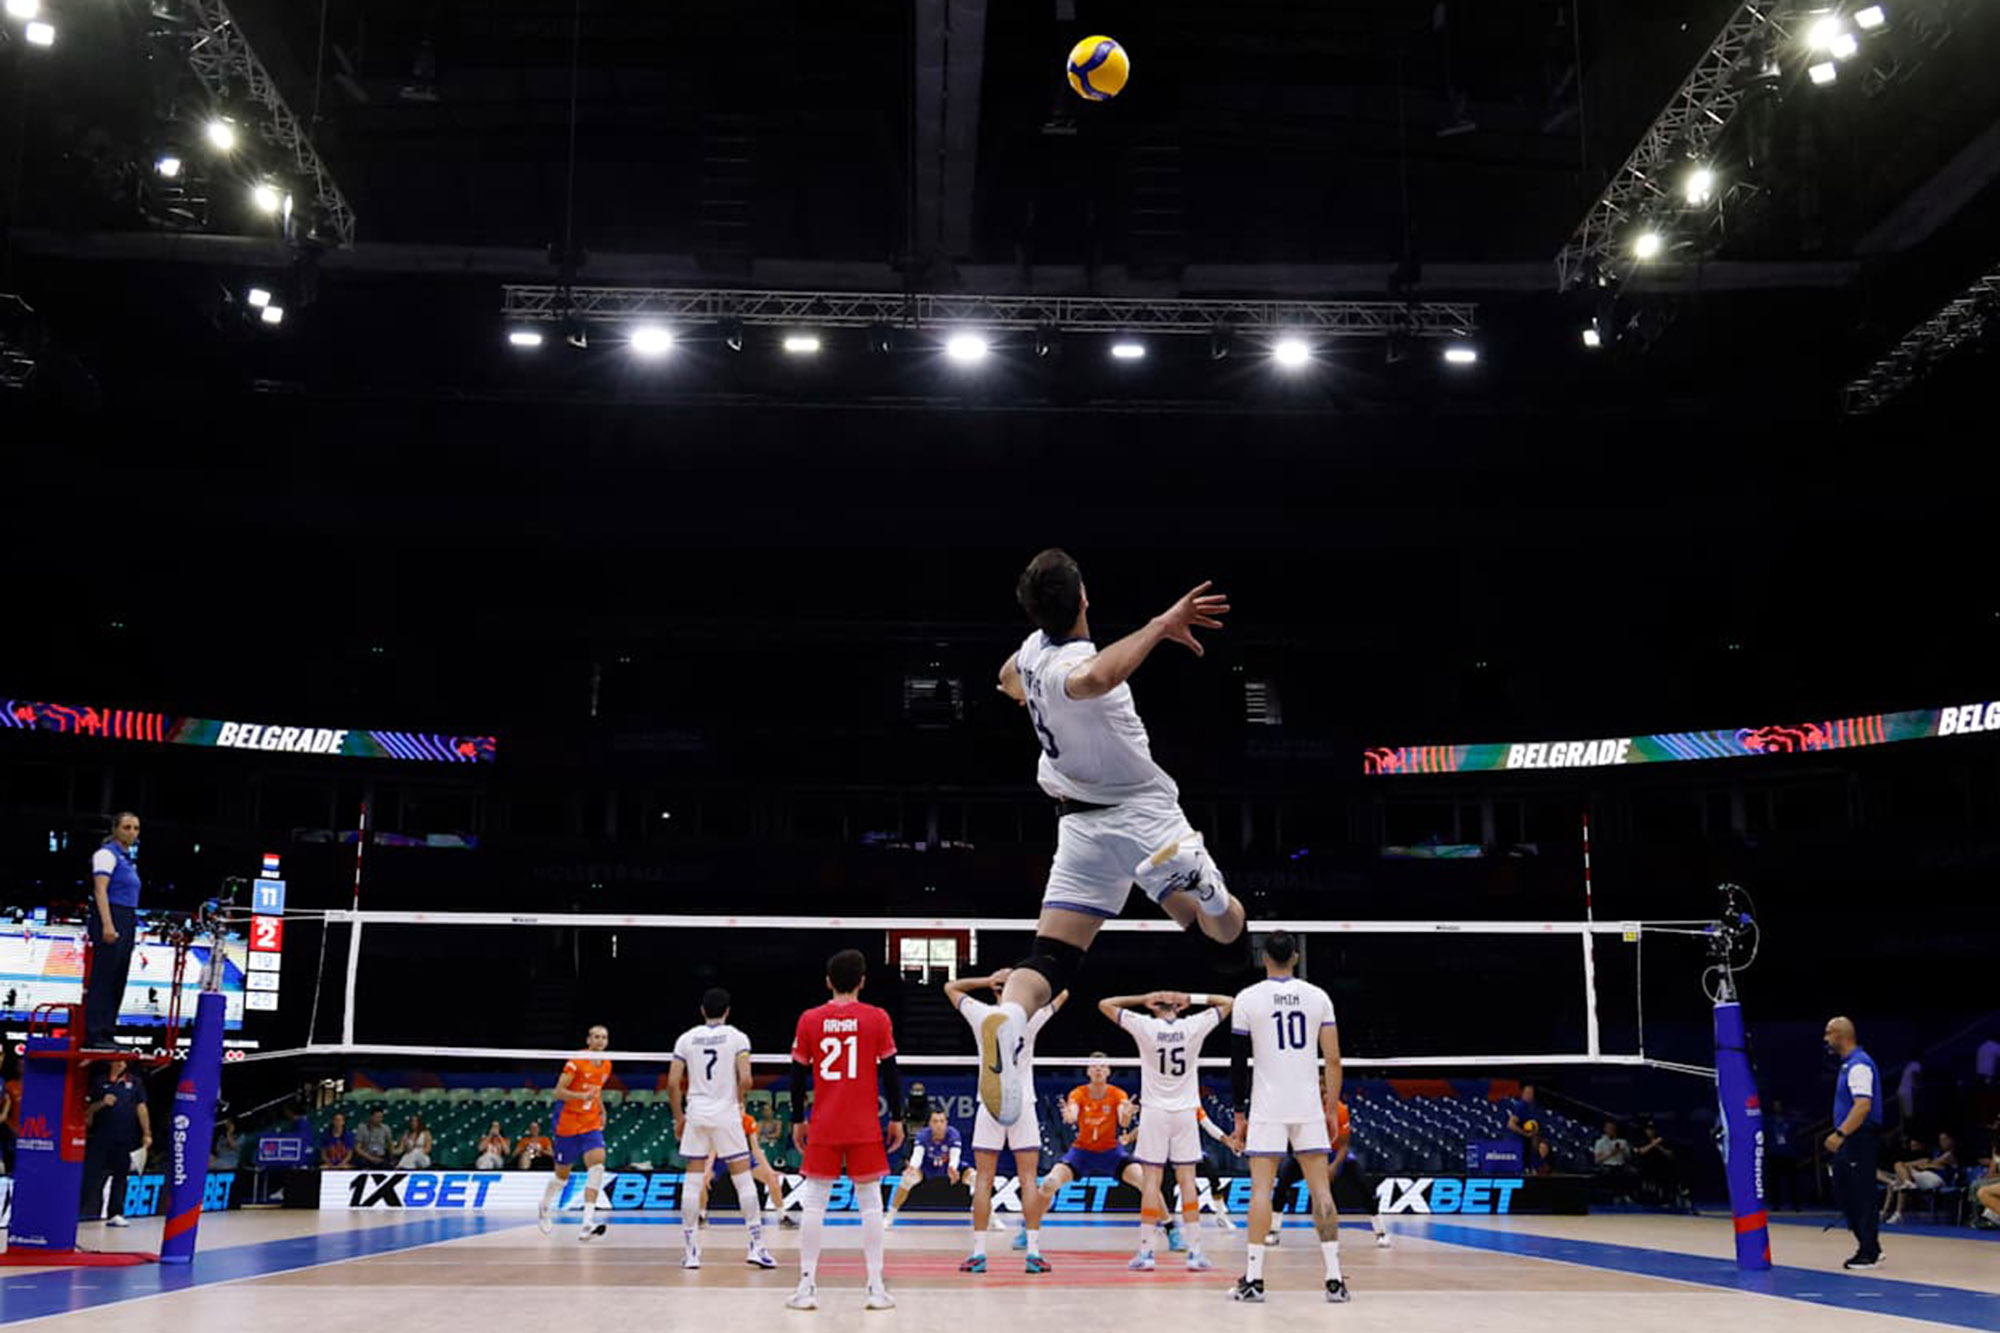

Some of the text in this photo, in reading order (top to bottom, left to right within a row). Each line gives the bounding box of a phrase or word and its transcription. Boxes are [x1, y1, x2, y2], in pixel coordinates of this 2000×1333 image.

[216, 721, 348, 754] BELGRADE
[1506, 738, 1631, 768] BELGRADE
[261, 887, 277, 907] 11
[257, 926, 276, 948] 2
[1271, 1010, 1306, 1050] 10
[703, 1049, 718, 1081] 7
[820, 1036, 858, 1080] 21
[1156, 1047, 1186, 1077] 15
[174, 1131, 187, 1186] Senoh
[348, 1173, 503, 1208] 1XBET
[1375, 1178, 1524, 1214] 1XBET
